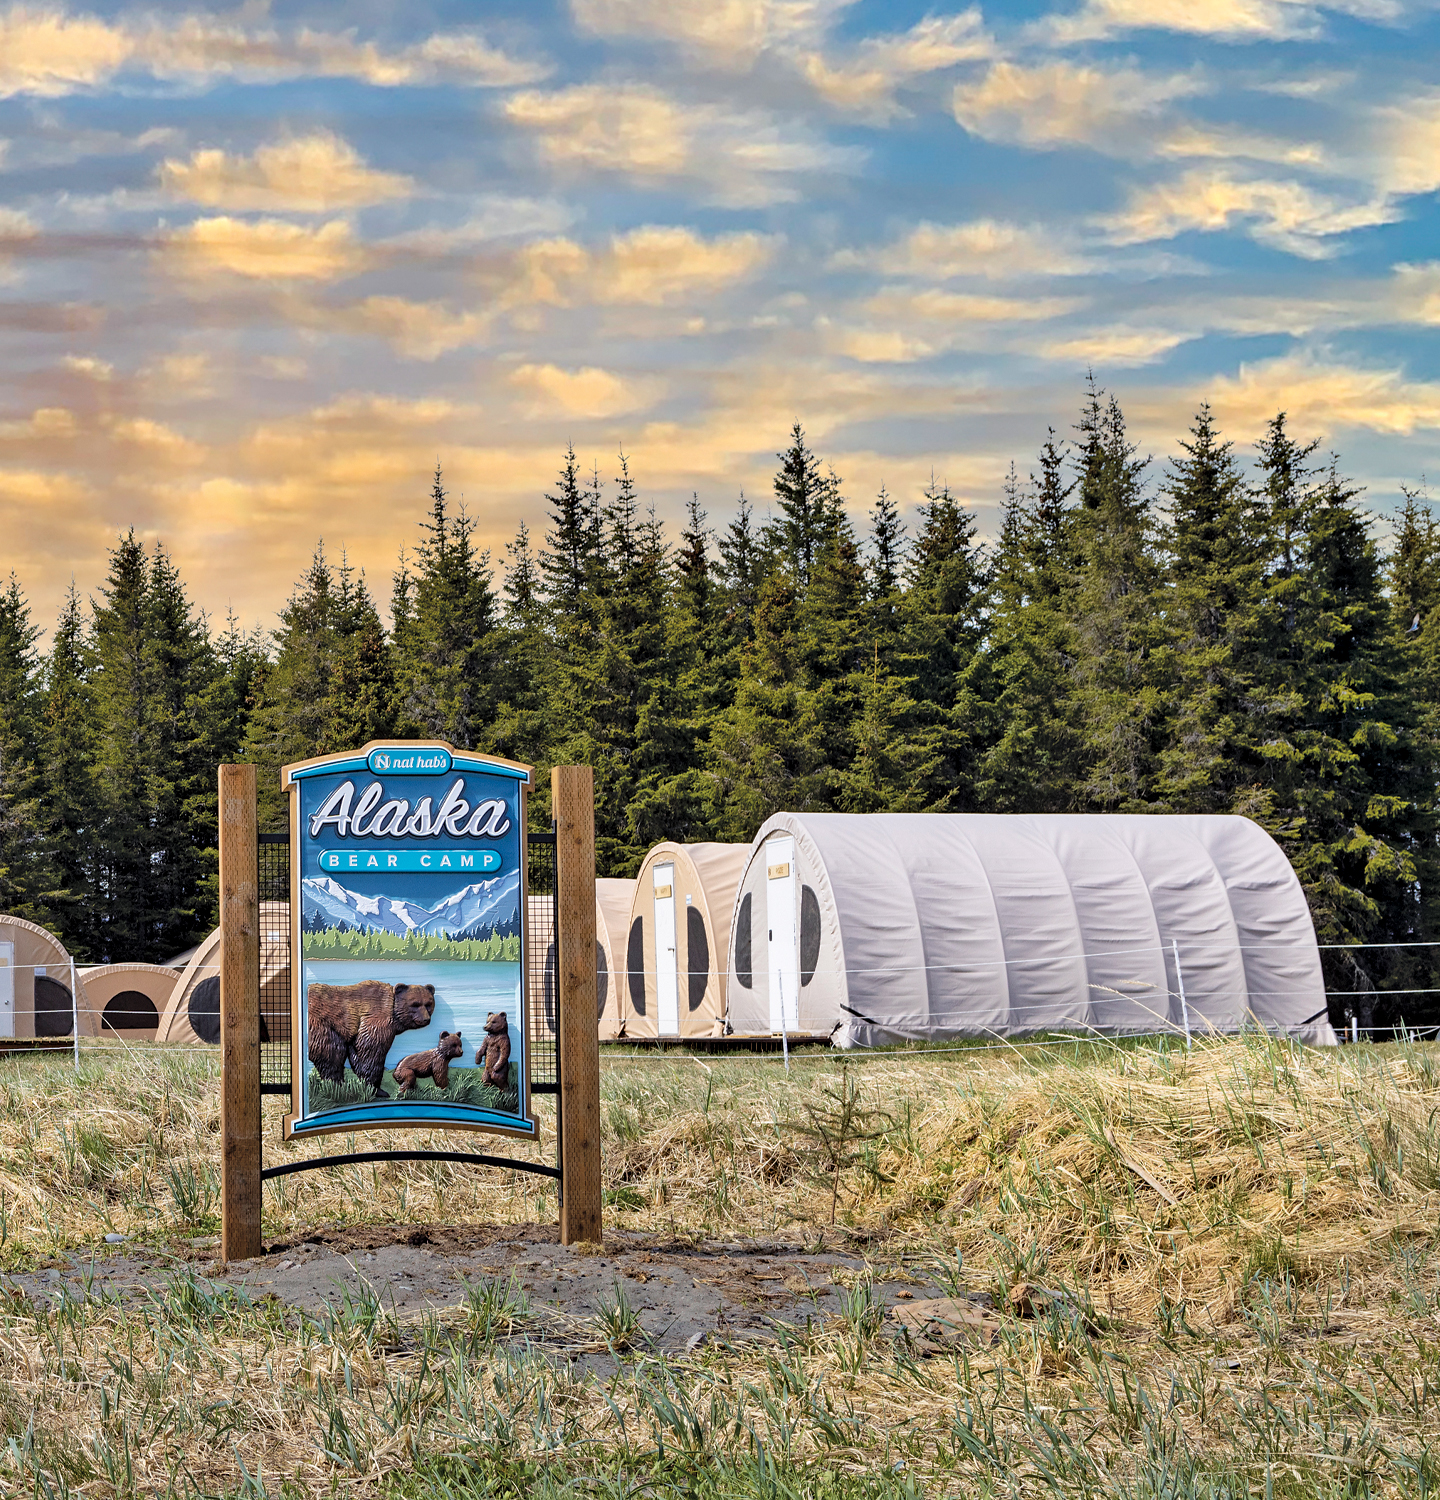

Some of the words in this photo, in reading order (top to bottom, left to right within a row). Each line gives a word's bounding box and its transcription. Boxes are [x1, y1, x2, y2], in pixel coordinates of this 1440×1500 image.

[392, 756, 415, 769] nat
[417, 754, 447, 769] hab's
[310, 778, 511, 838] Alaska
[328, 854, 398, 867] BEAR
[419, 854, 495, 867] CAMP
